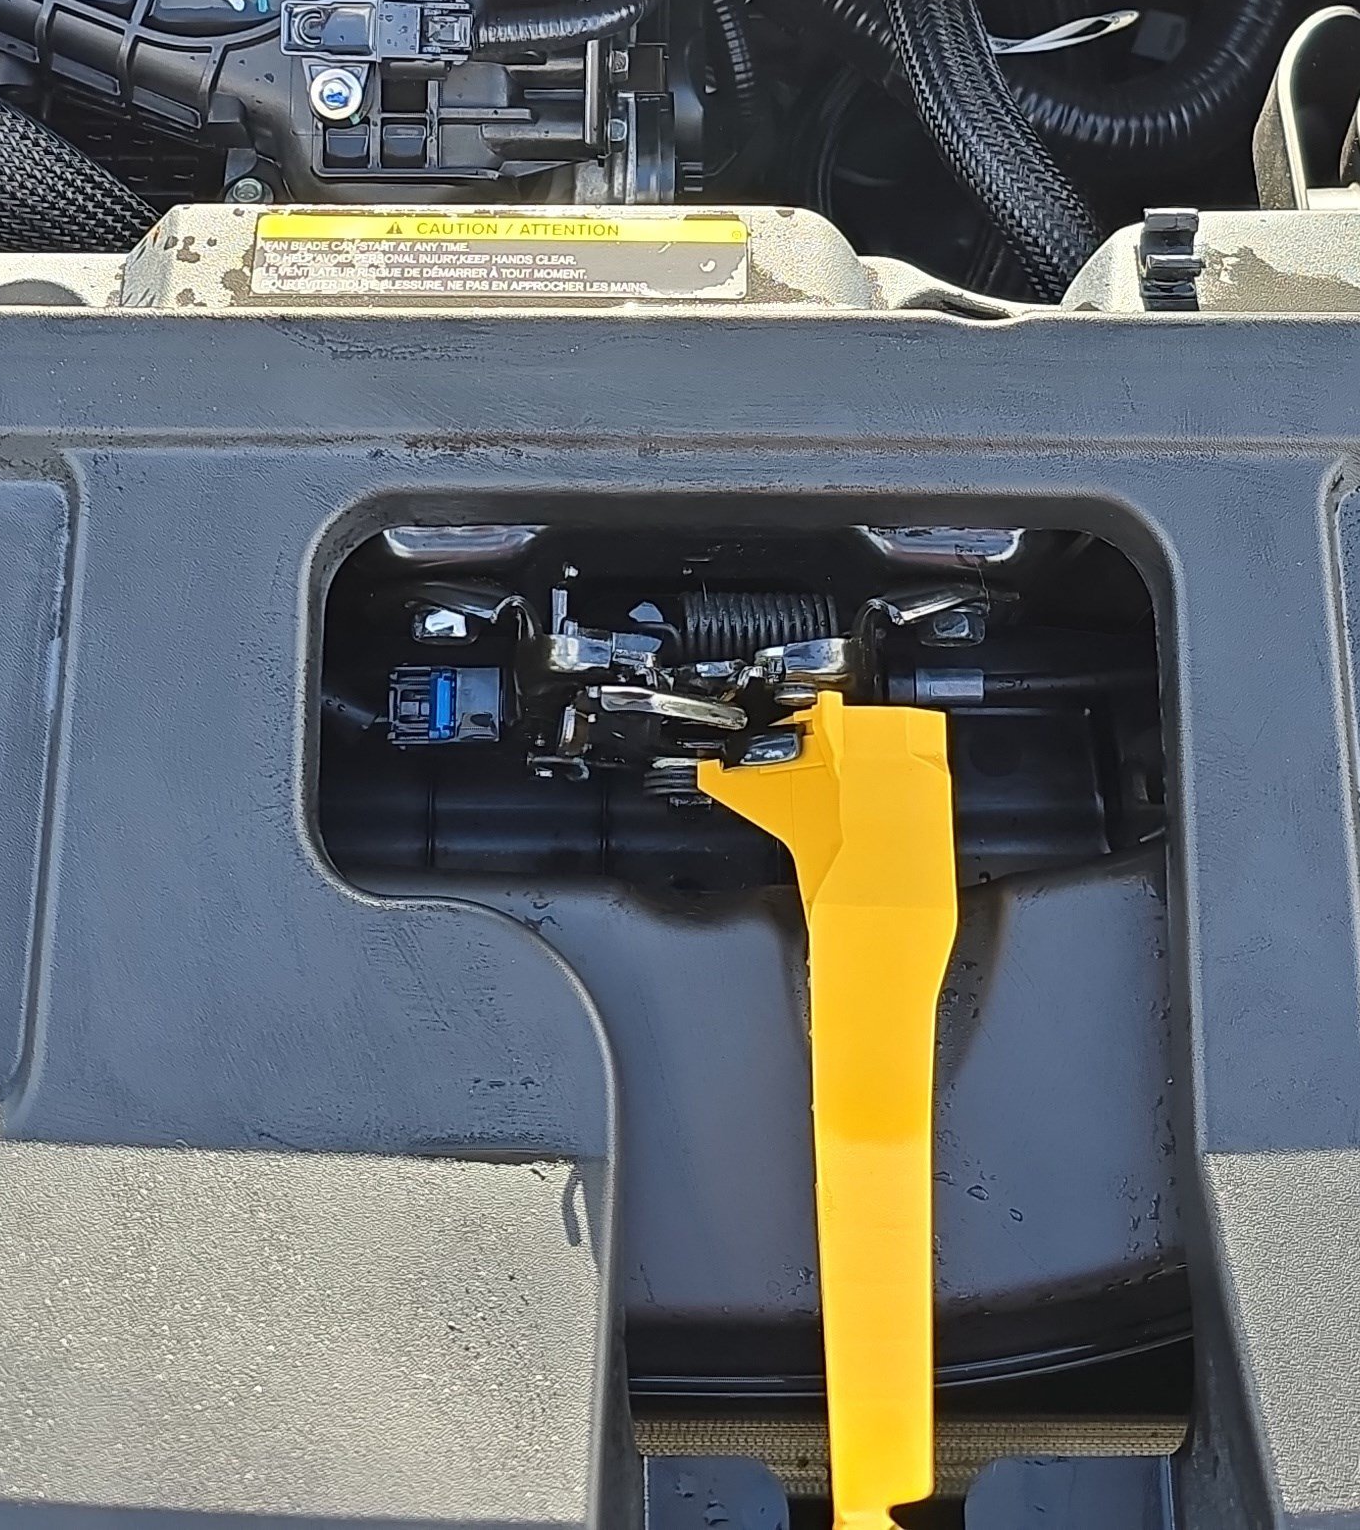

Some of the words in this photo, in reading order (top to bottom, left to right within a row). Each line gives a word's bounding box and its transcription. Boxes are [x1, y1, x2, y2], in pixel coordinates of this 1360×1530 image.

[417, 222, 498, 236] CAUTION
[519, 223, 620, 237] ATTENTION
[290, 241, 330, 252] BLADE
[331, 241, 357, 252] CAN
[358, 242, 396, 252] START
[397, 242, 413, 252] AT
[414, 242, 439, 252] ANY
[264, 252, 281, 264] TO
[315, 253, 353, 264] AVOID
[354, 253, 417, 264] PERSONAL
[491, 254, 534, 266] HANDS
[535, 255, 578, 266] CLEAR.
[278, 266, 356, 278] VENTILATEUR
[357, 267, 403, 278] RISQUE
[404, 268, 421, 278] DE
[423, 265, 488, 278] DÉMARRER
[489, 266, 499, 278] À
[499, 268, 532, 279] TOUT
[533, 268, 588, 280] MOMENT.
[382, 279, 445, 292] BLESSURE,
[446, 280, 464, 291] NE
[465, 280, 490, 291] PAS
[491, 281, 509, 291] EN
[509, 281, 584, 293] APPROCHER
[585, 282, 609, 293] LES
